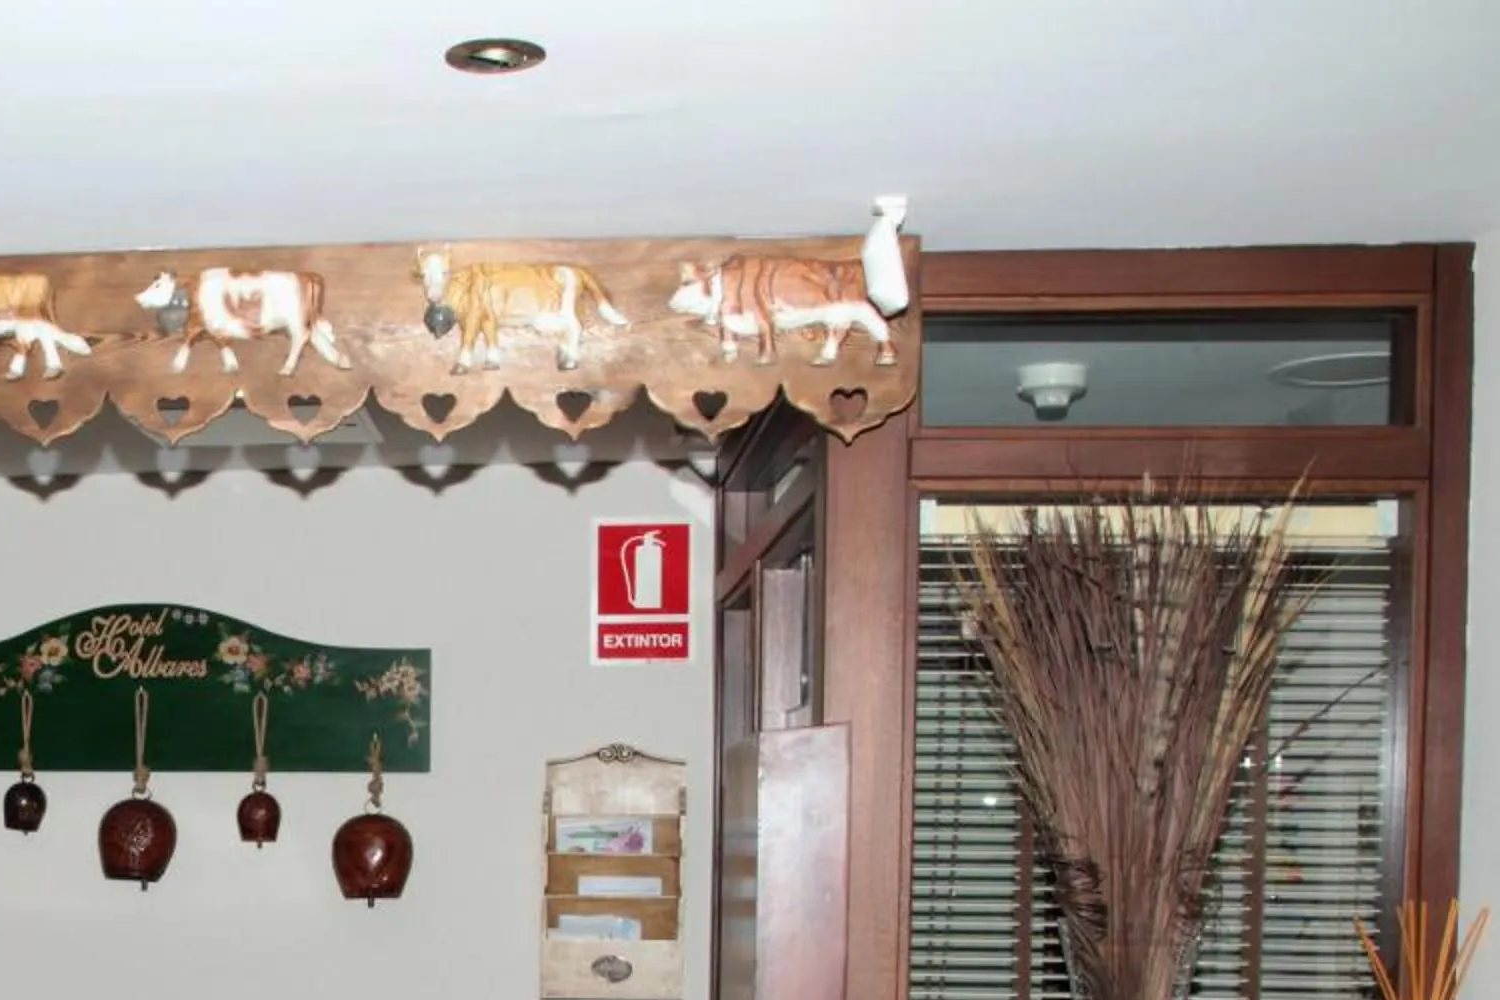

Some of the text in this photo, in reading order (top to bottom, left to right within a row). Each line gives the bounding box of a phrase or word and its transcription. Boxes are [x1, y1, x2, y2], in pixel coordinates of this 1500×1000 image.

[75, 608, 169, 660] Hotel
[603, 633, 683, 649] EXTINTOR
[93, 636, 207, 679] Albares
